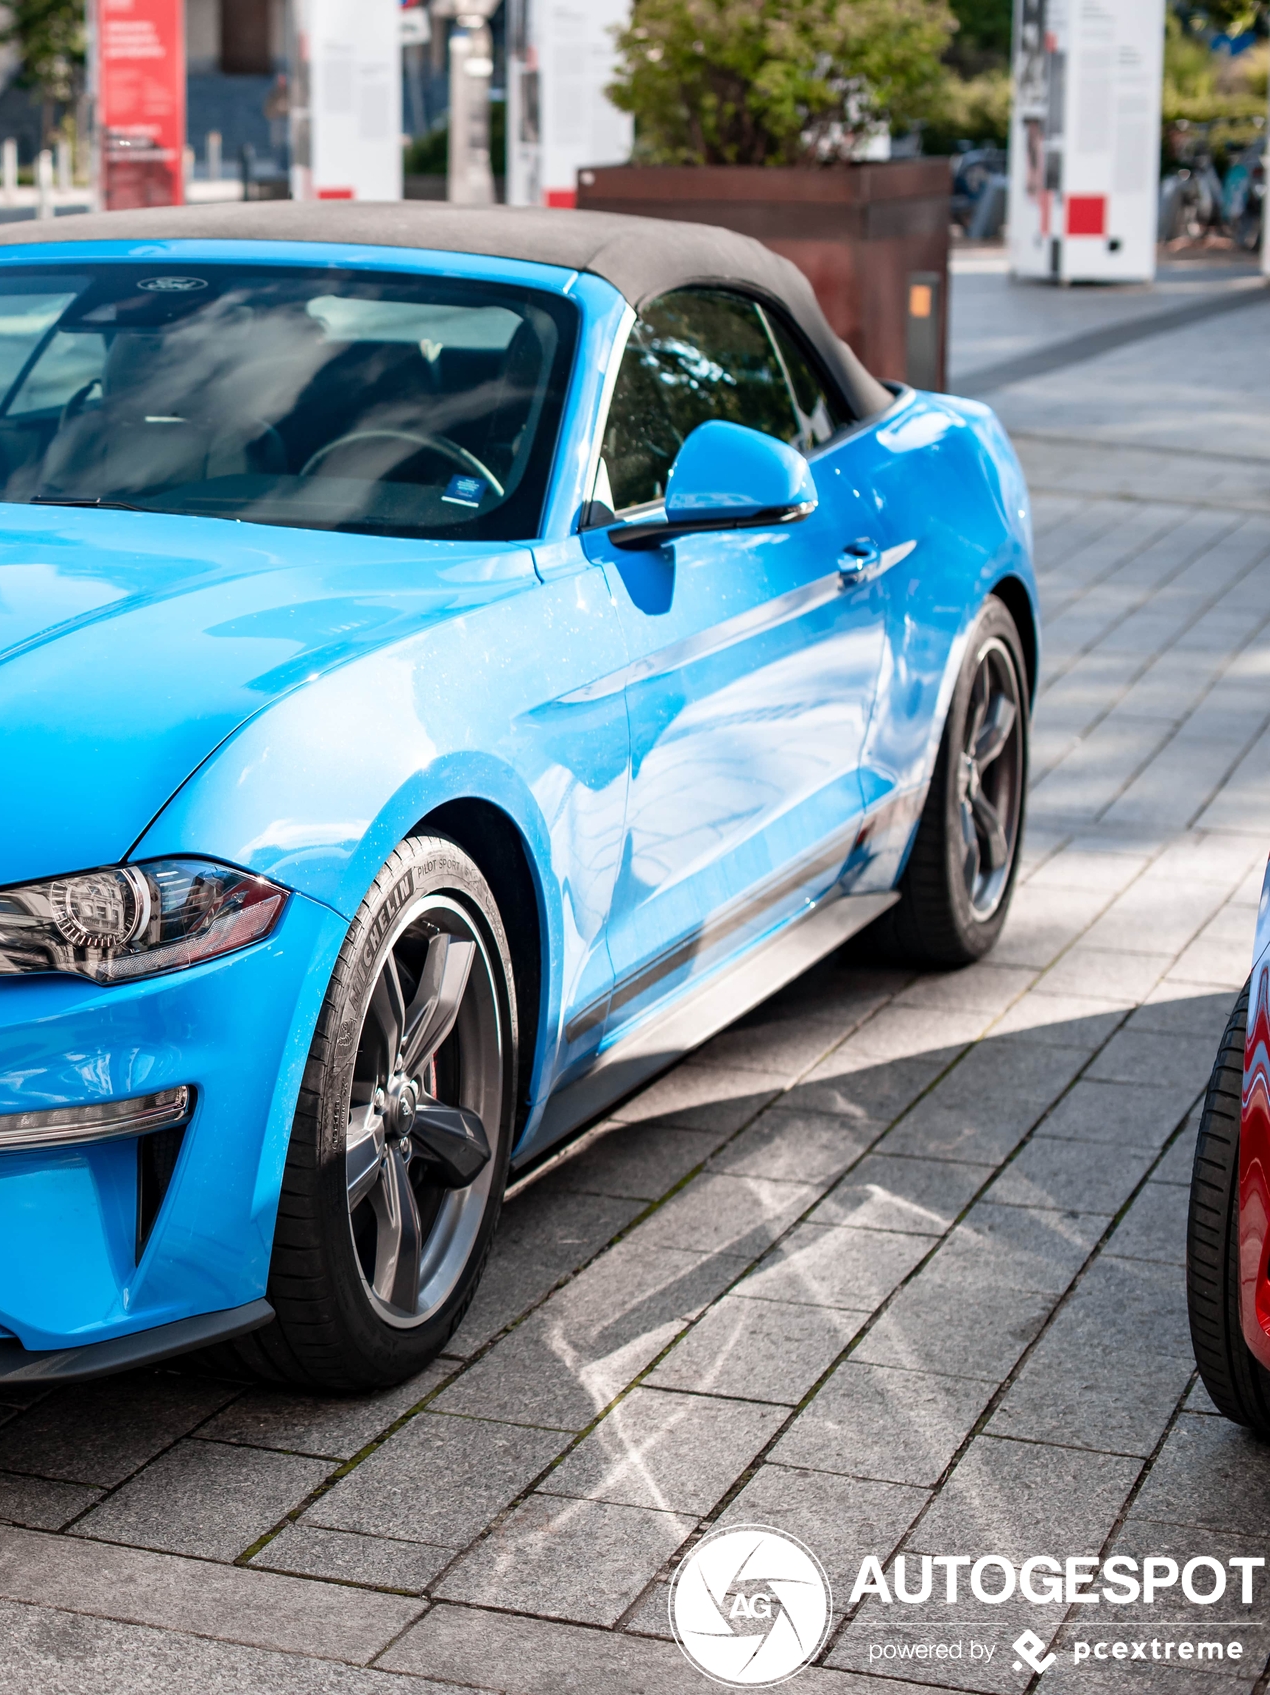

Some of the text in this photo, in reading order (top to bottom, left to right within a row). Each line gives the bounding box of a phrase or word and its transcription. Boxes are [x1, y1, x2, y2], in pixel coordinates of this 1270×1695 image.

[417, 858, 461, 878] PILOT SPORT
[348, 875, 411, 1003] MICHELIN
